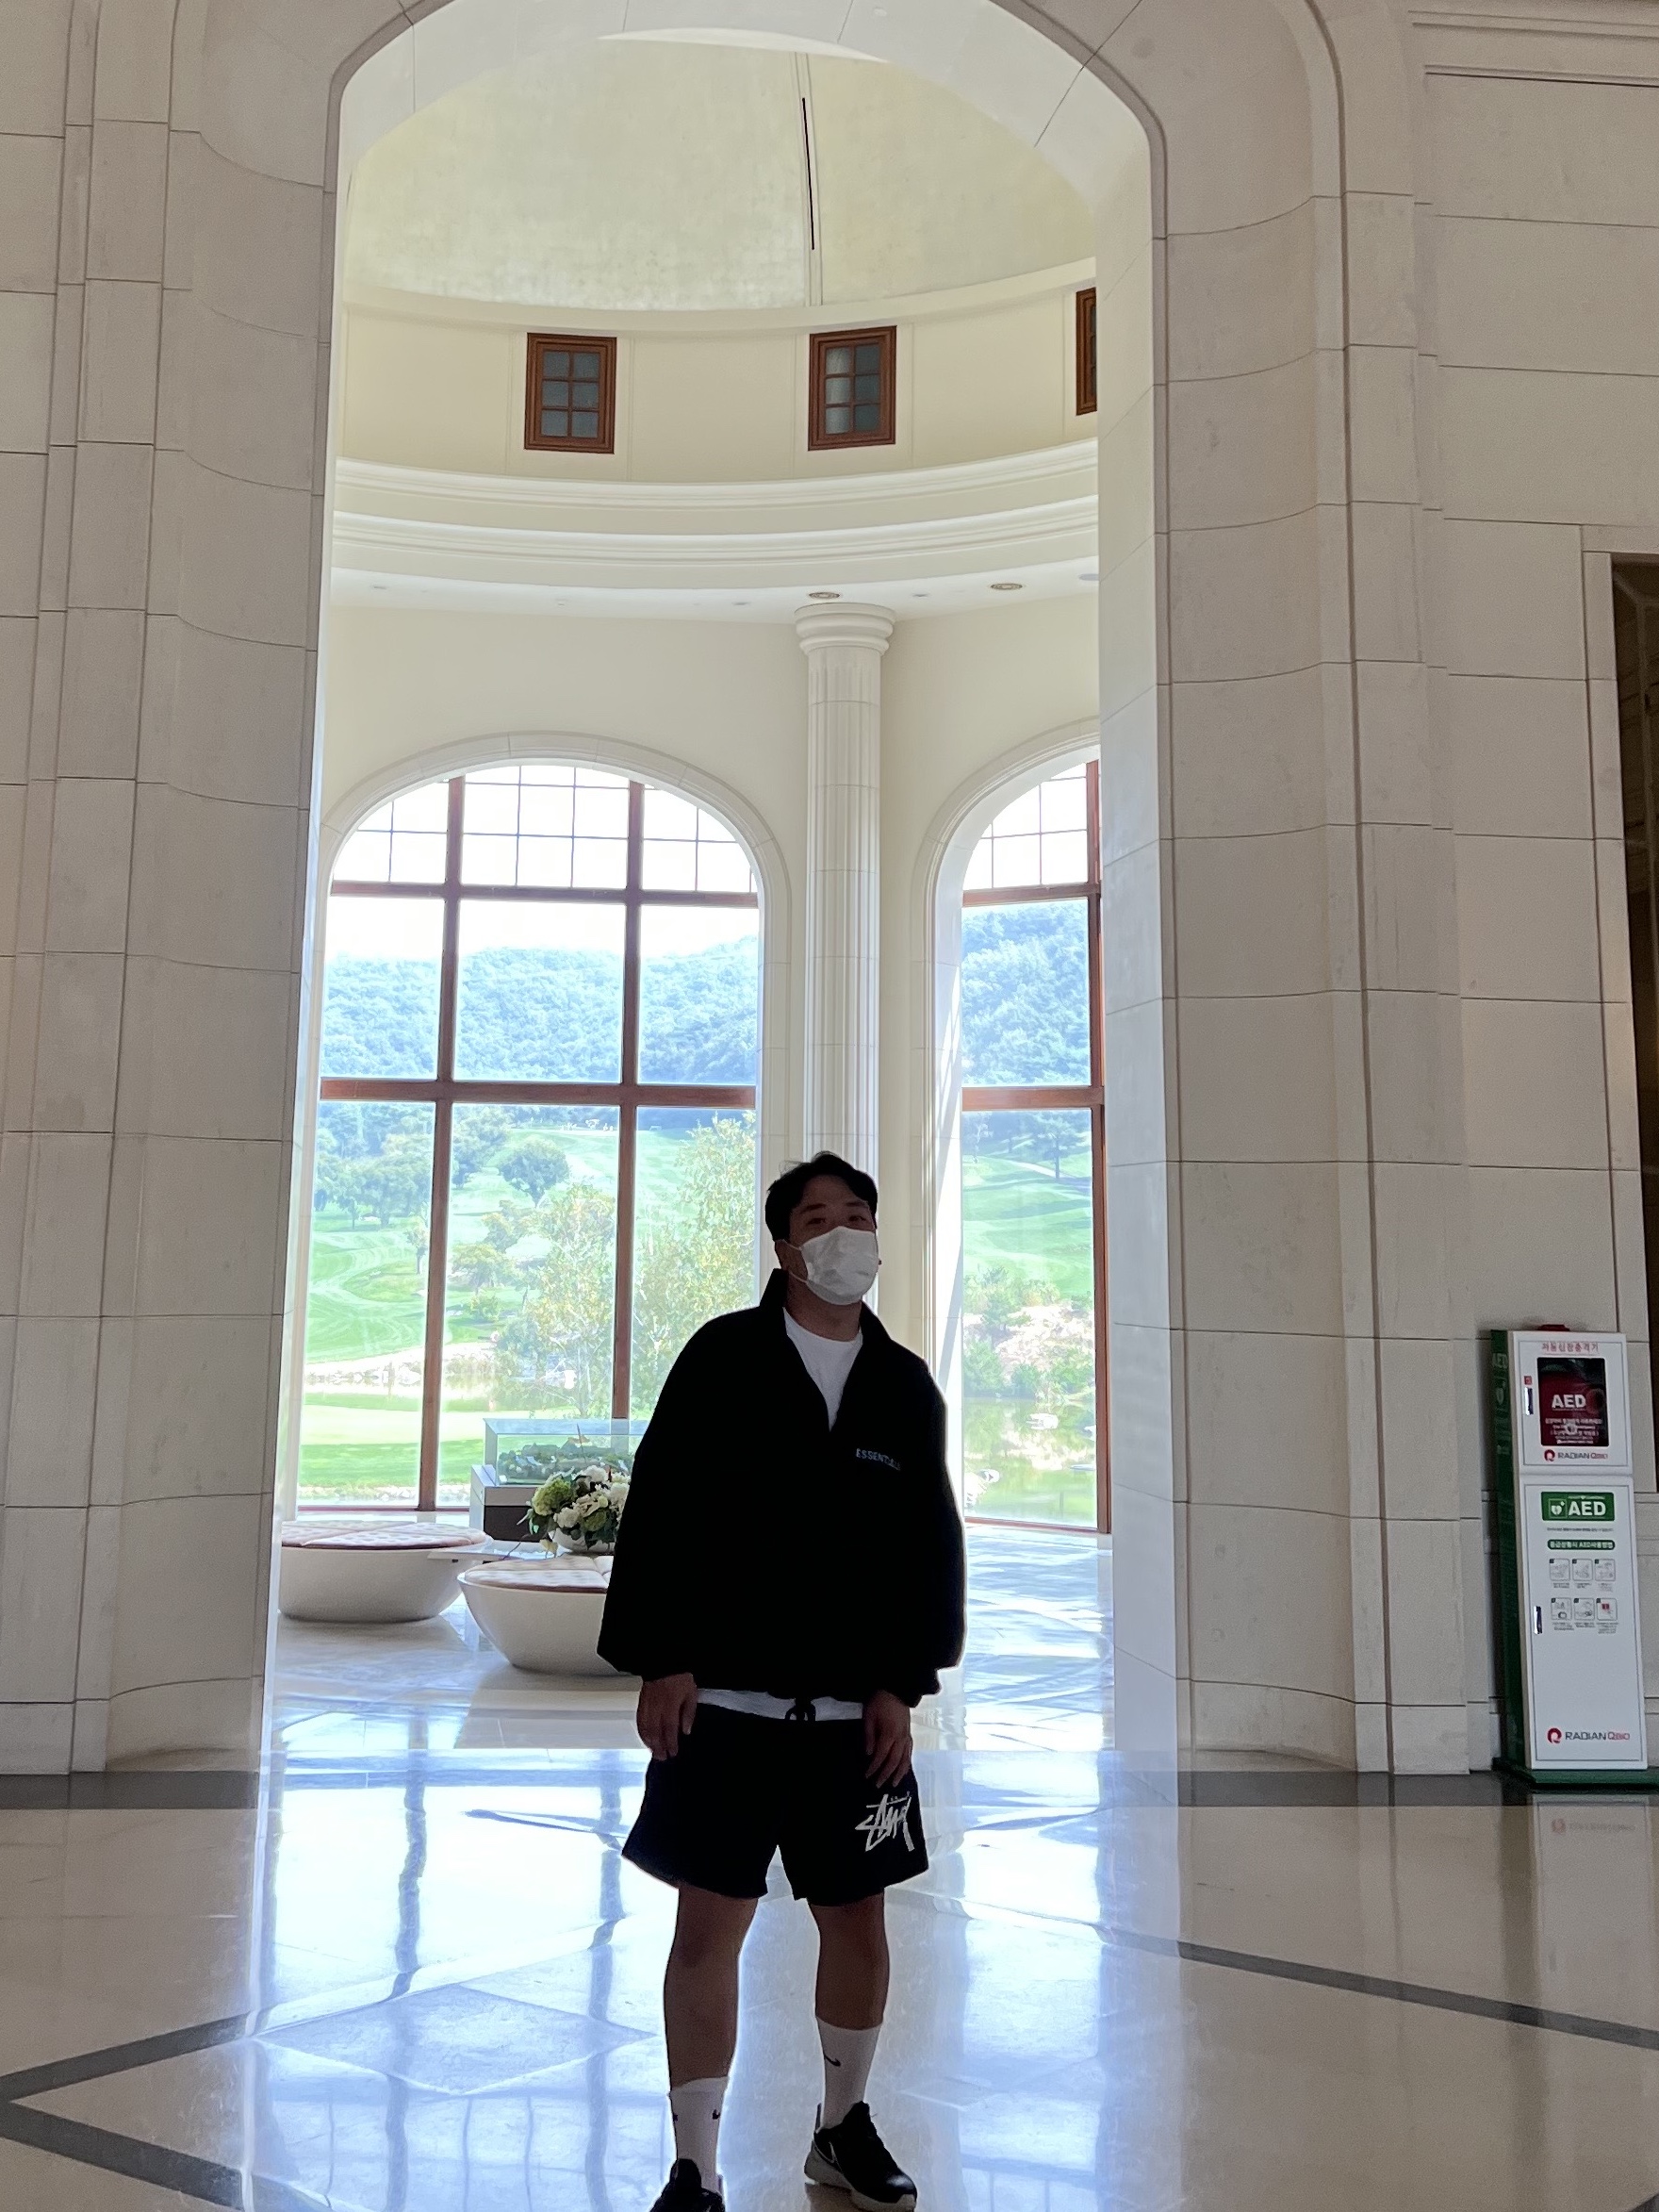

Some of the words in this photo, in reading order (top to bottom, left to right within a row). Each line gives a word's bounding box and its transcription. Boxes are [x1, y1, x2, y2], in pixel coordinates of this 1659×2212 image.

[1552, 1395, 1586, 1408] AED
[1568, 1501, 1606, 1516] AED
[1565, 1731, 1606, 1741] RADIAN
